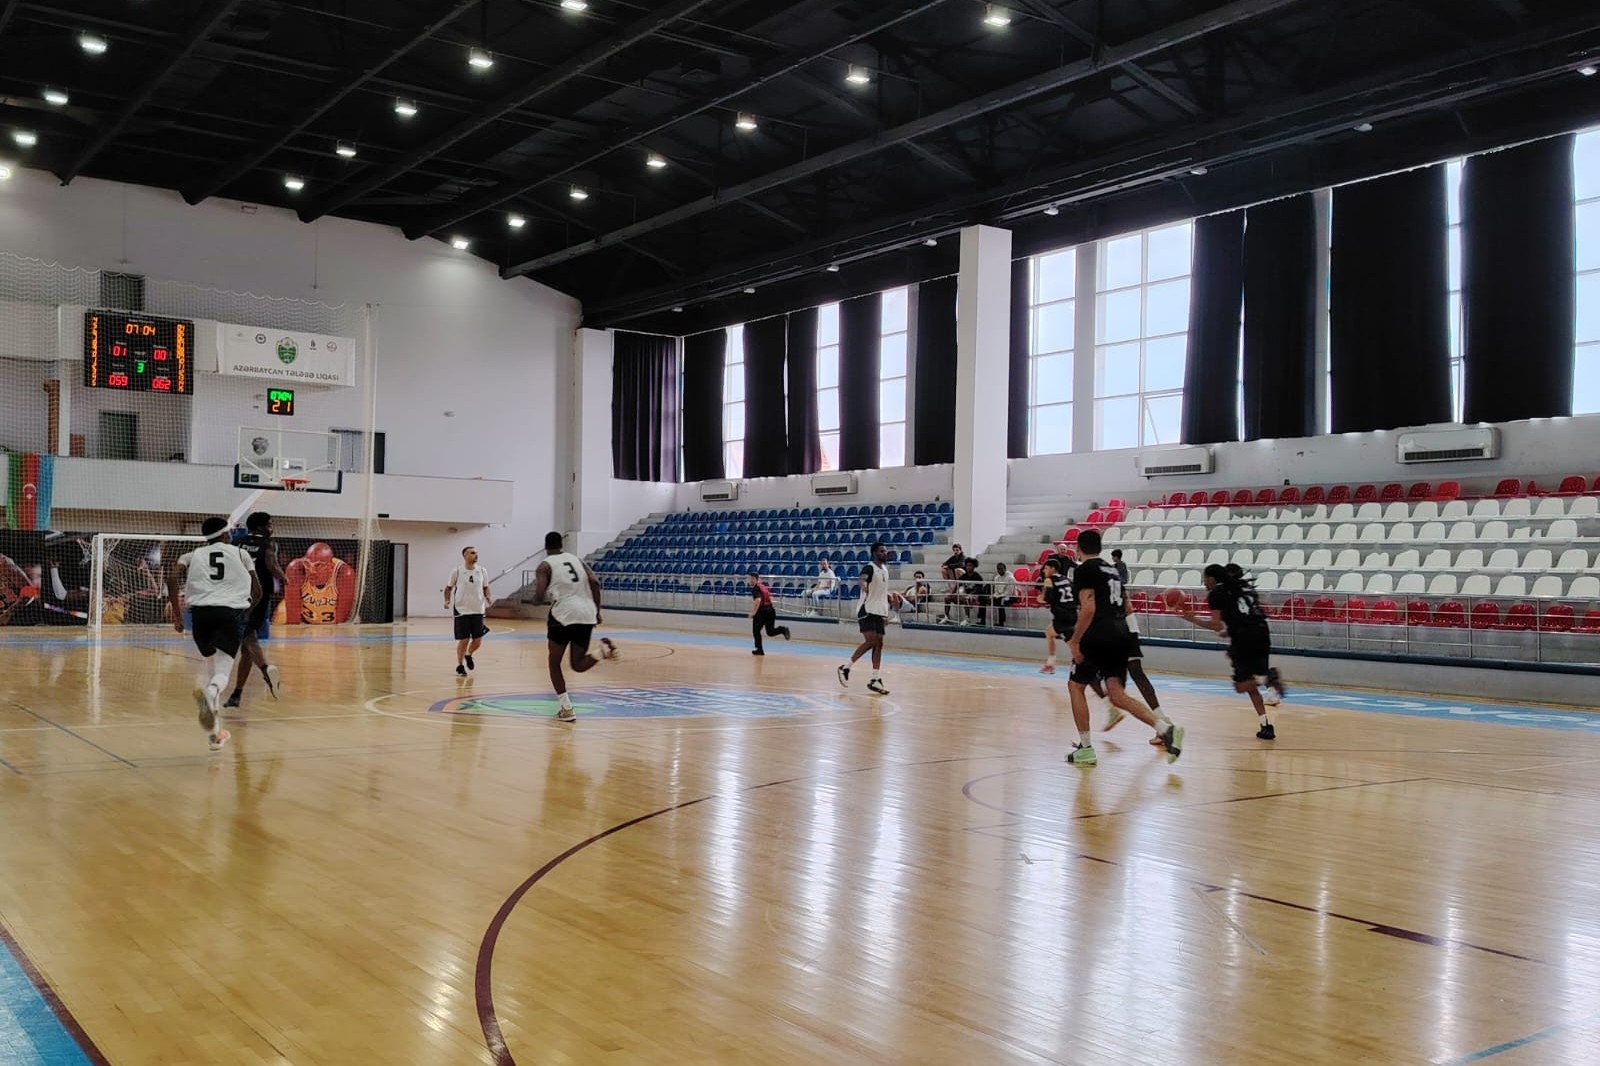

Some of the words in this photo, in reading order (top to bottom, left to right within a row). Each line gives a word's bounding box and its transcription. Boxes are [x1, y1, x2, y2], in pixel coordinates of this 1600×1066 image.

[112, 345, 127, 357] 01
[153, 349, 167, 361] 00
[136, 362, 145, 373] 3
[233, 364, 284, 376] AZƏRBAYCAN
[108, 374, 129, 386] 059
[151, 377, 172, 390] 062
[272, 400, 292, 412] 21
[209, 552, 225, 580] 5
[563, 562, 579, 583] 3
[469, 575, 474, 583] 4
[1058, 586, 1074, 603] 23
